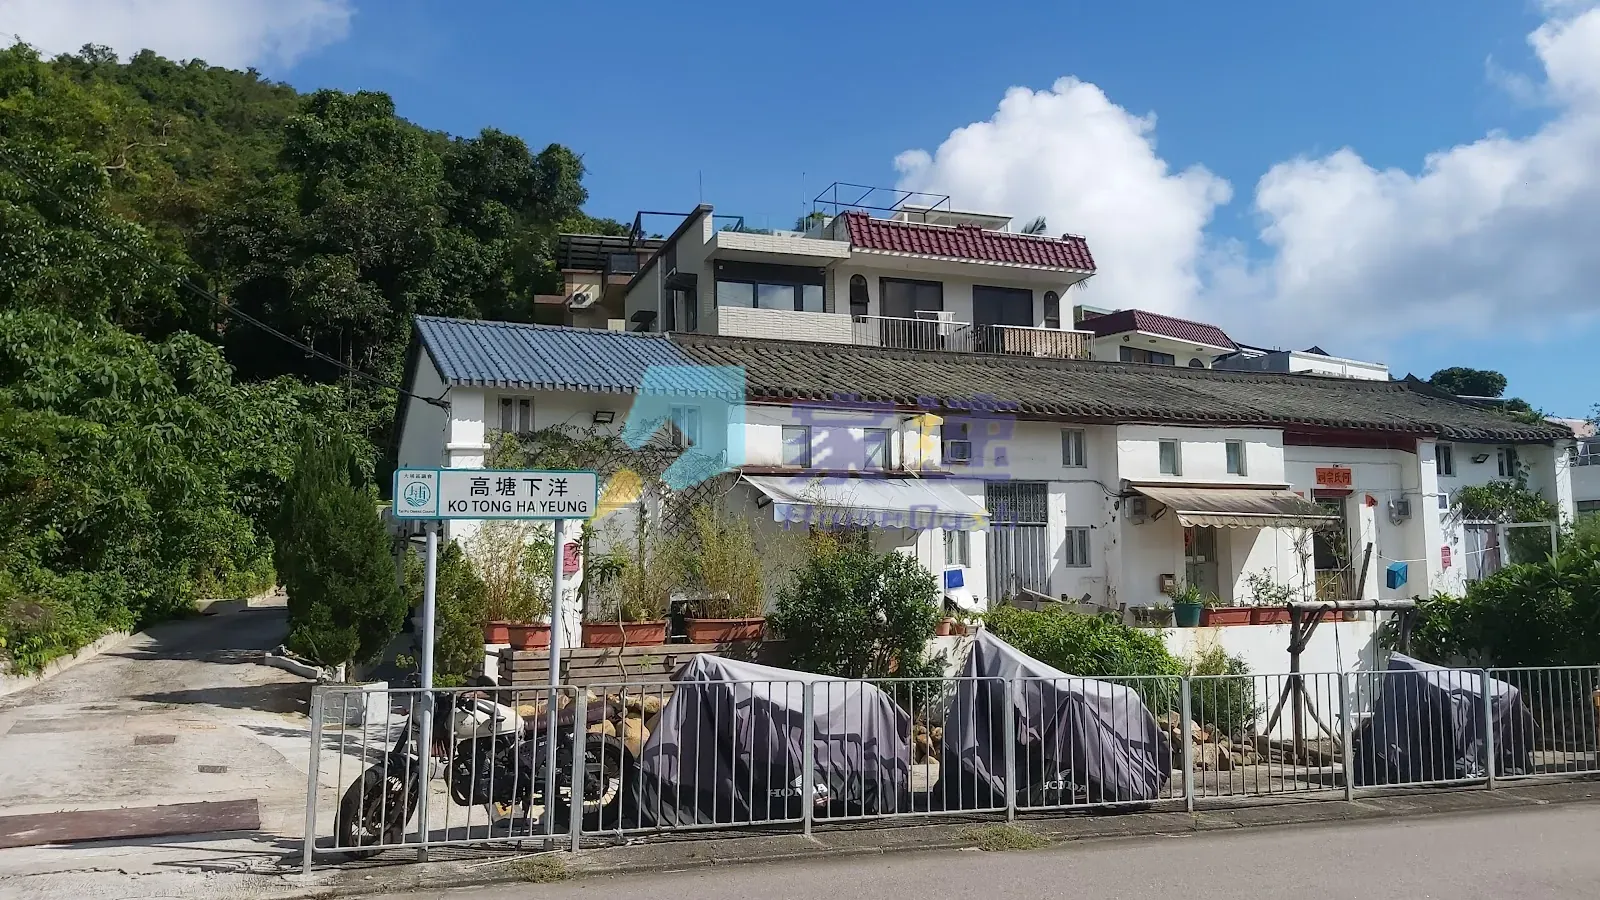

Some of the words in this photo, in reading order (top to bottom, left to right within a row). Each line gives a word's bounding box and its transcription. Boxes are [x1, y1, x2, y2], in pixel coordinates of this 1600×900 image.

[470, 477, 568, 497] 高塘下洋
[448, 500, 468, 513] KO
[472, 500, 512, 513] TONG
[516, 500, 535, 513] HA
[539, 500, 588, 513] YEUNG
